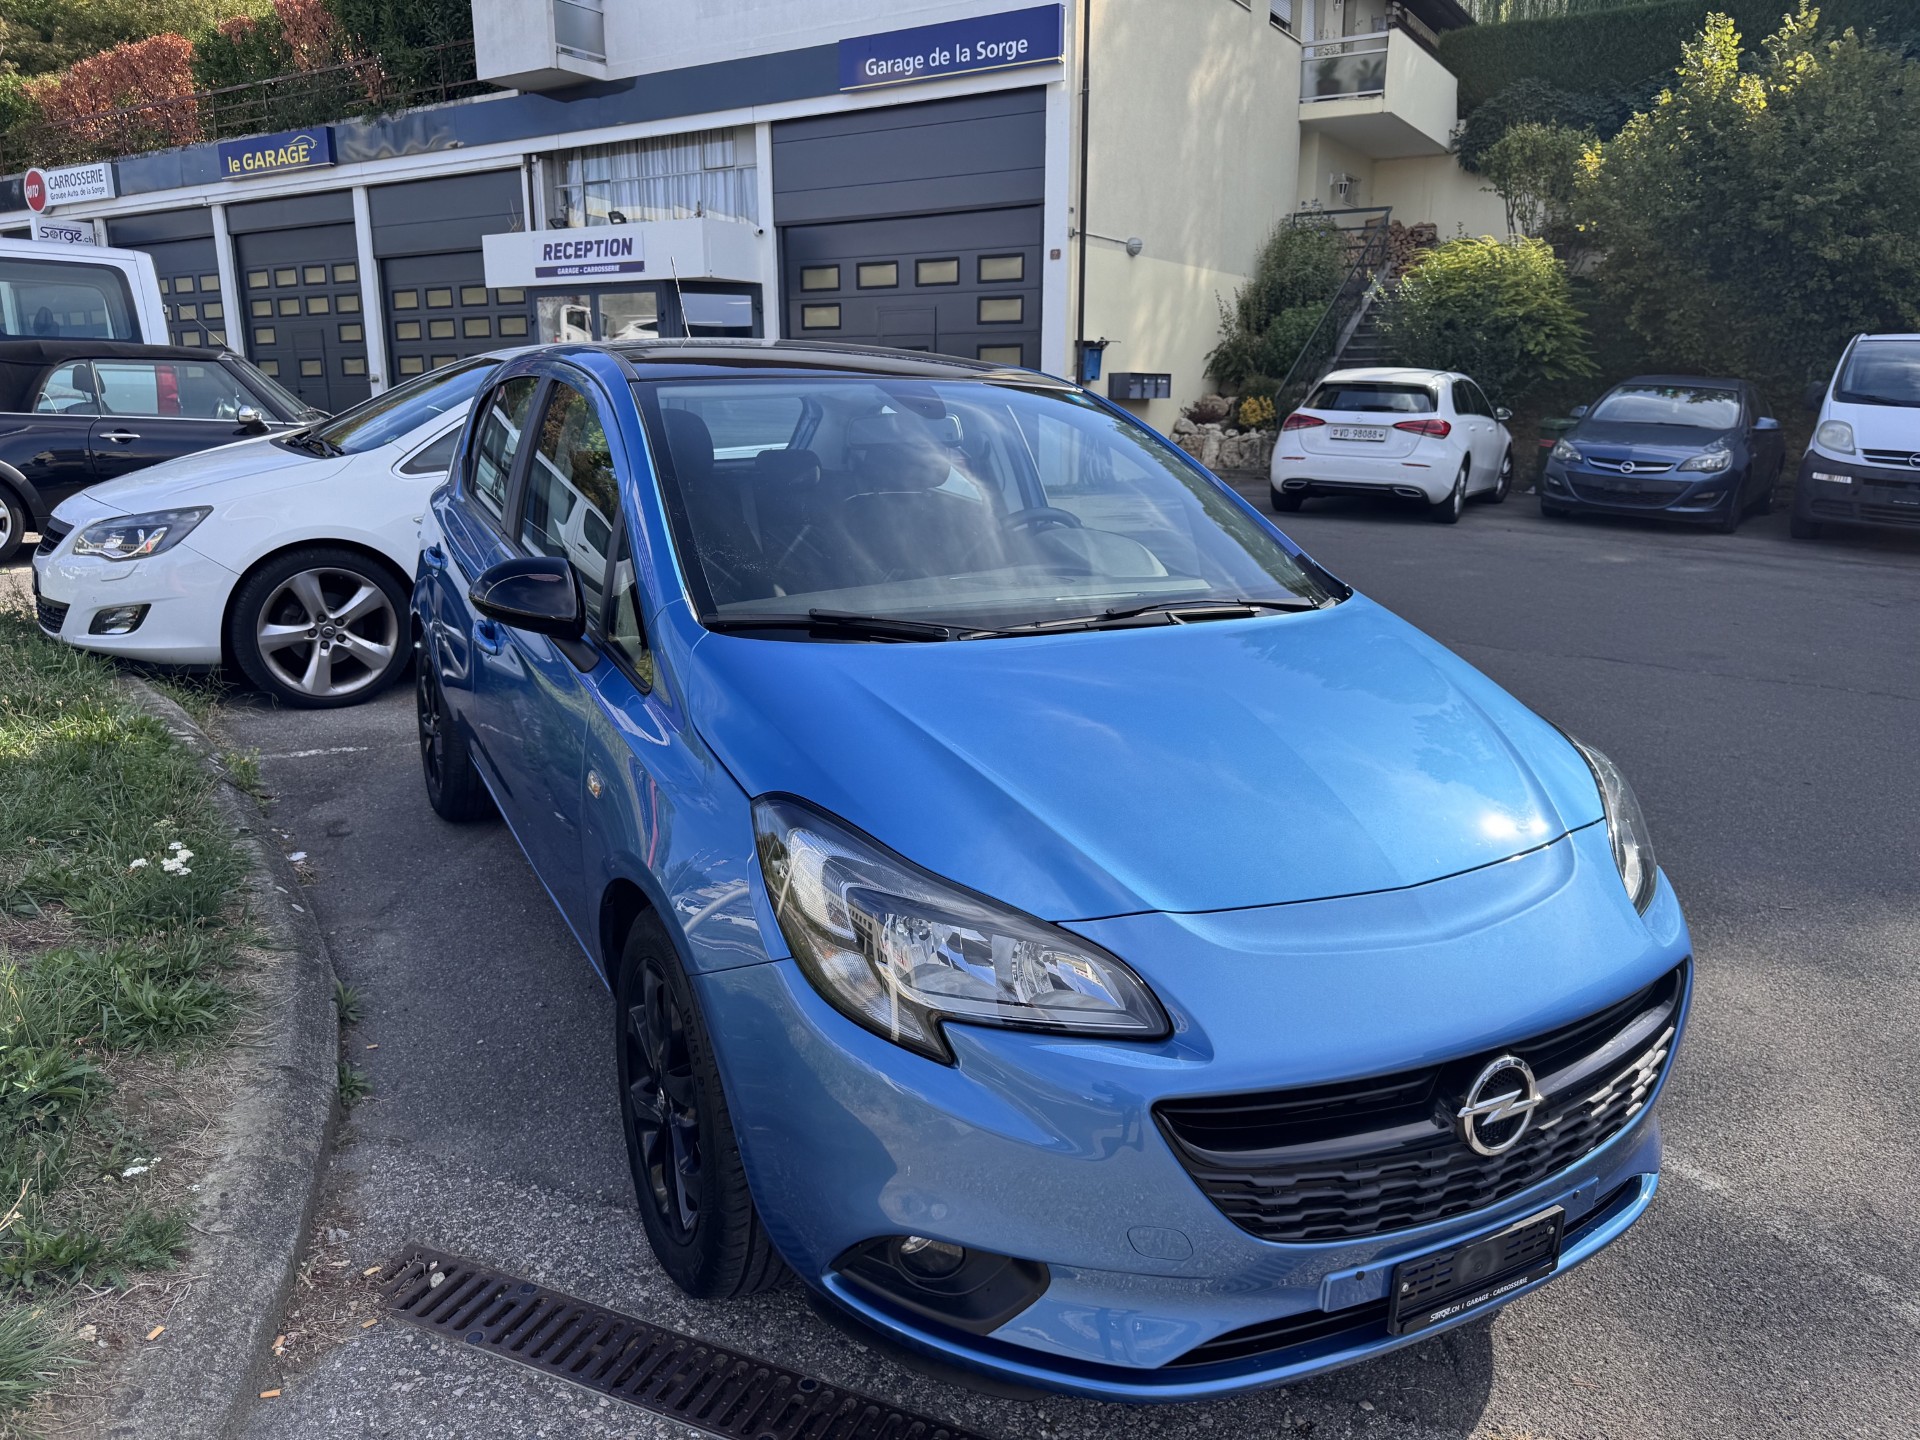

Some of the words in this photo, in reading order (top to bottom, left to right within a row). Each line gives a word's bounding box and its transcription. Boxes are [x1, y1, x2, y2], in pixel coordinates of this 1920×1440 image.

[865, 54, 924, 76] Garage
[929, 47, 950, 67] de
[956, 44, 970, 63] la
[976, 39, 1028, 60] Sorge
[228, 156, 240, 173] le
[243, 144, 310, 170] GARAGE
[48, 169, 104, 190] CARROSSERIE
[50, 192, 66, 201] Groupe
[80, 187, 86, 195] de
[91, 186, 105, 195] Sorge
[543, 237, 633, 261] RECEPTION
[557, 266, 579, 275] GARAGE
[583, 264, 620, 273] CARROSSERIE
[1466, 1294, 1489, 1307] GARAGE
[1493, 1276, 1528, 1296] CARROSSERIE
